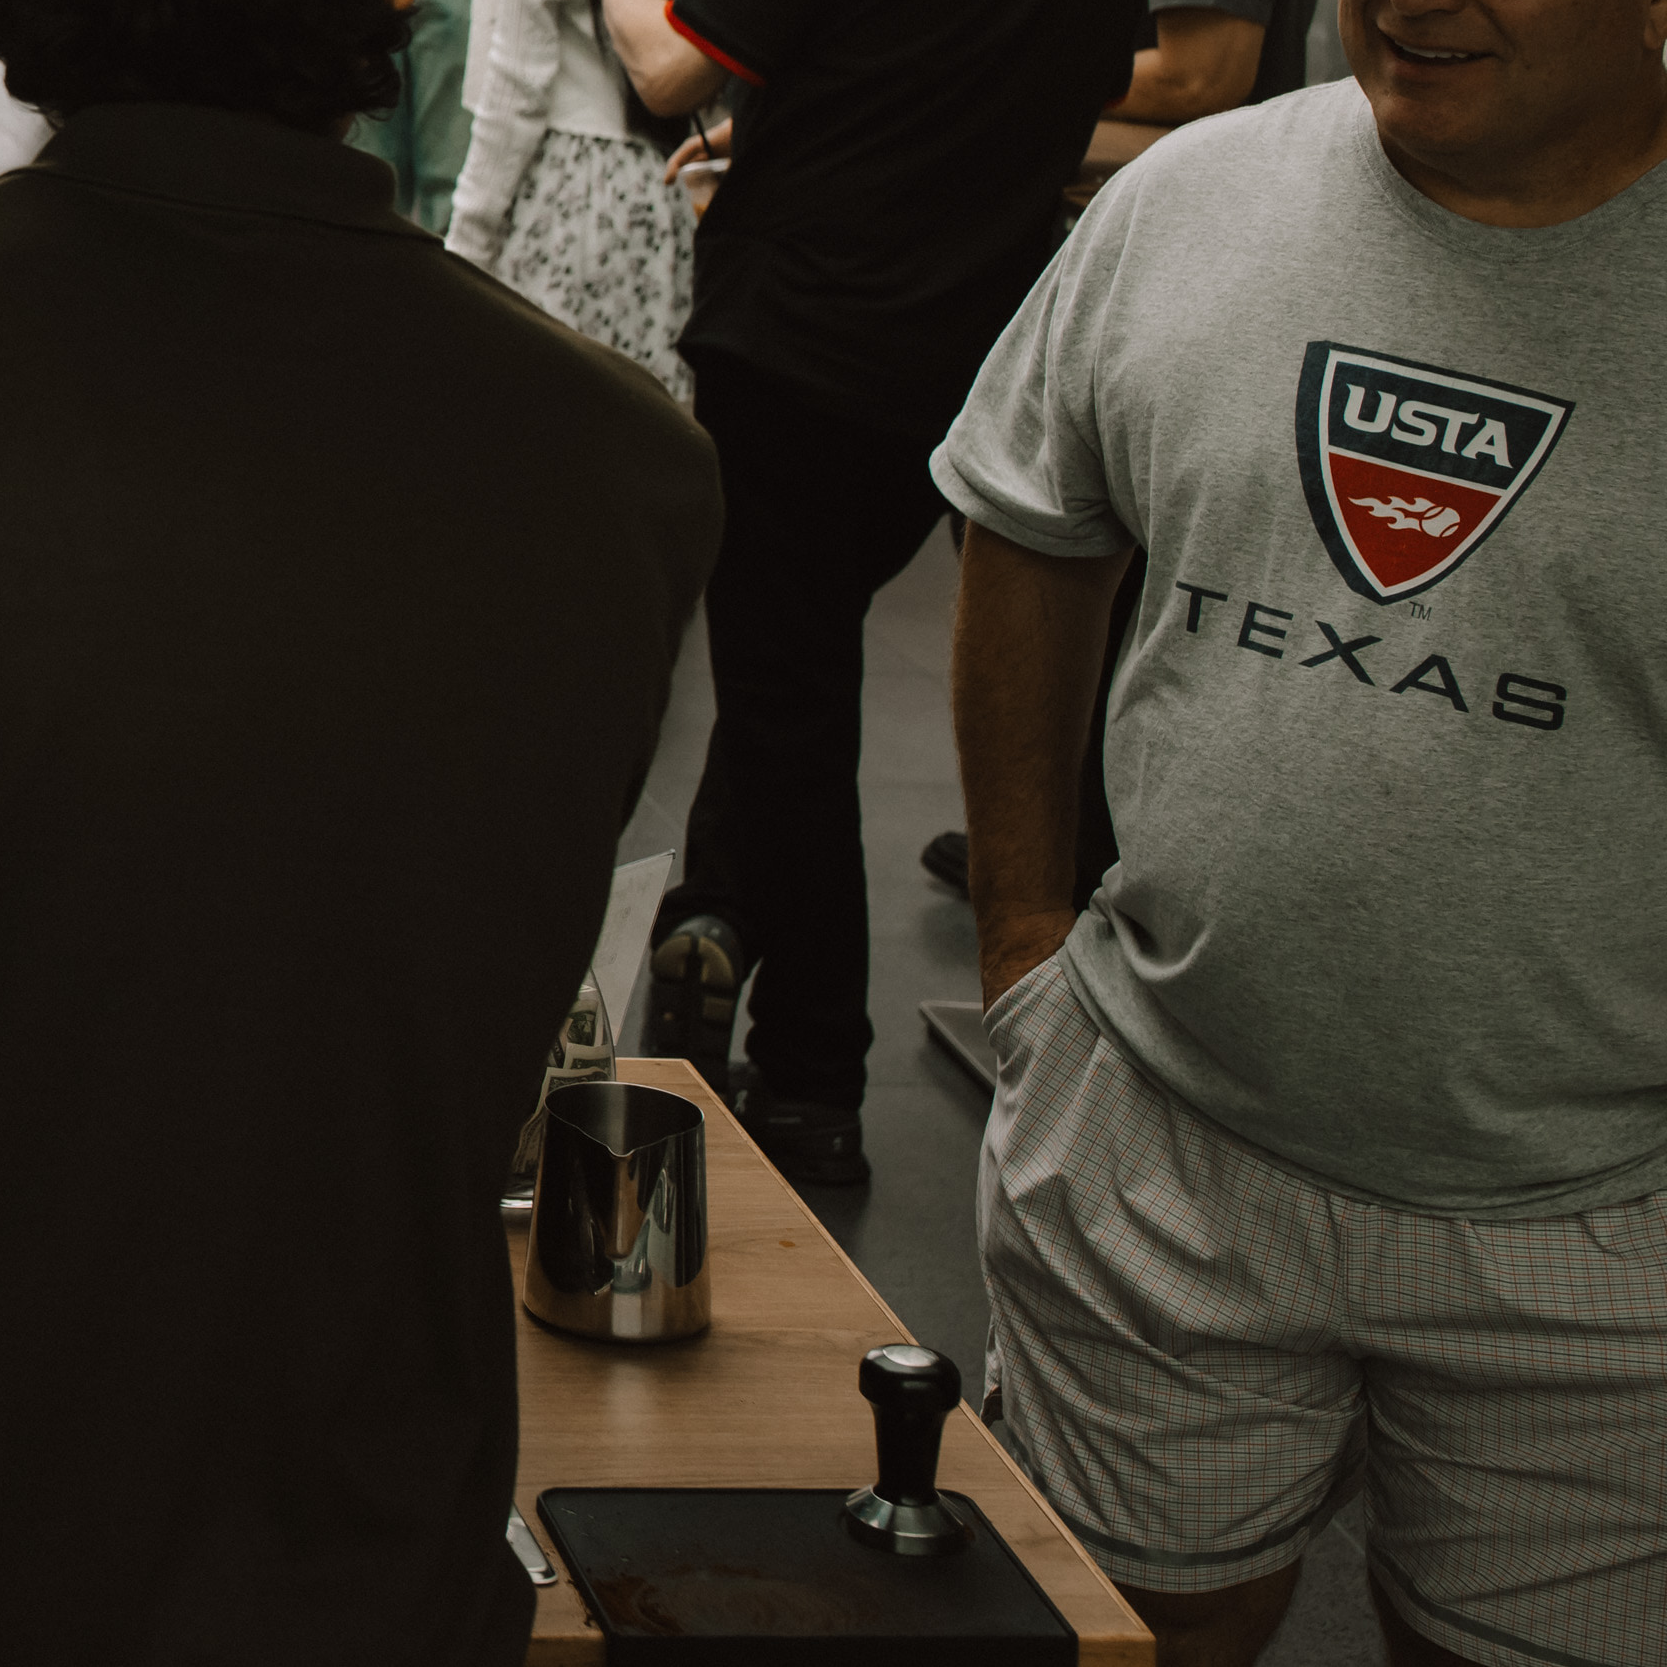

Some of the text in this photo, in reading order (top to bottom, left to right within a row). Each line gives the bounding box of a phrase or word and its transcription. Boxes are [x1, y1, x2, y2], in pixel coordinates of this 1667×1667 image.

[1343, 383, 1514, 469] USTA
[1408, 600, 1433, 622] TM
[1175, 579, 1568, 732] TEXAS
